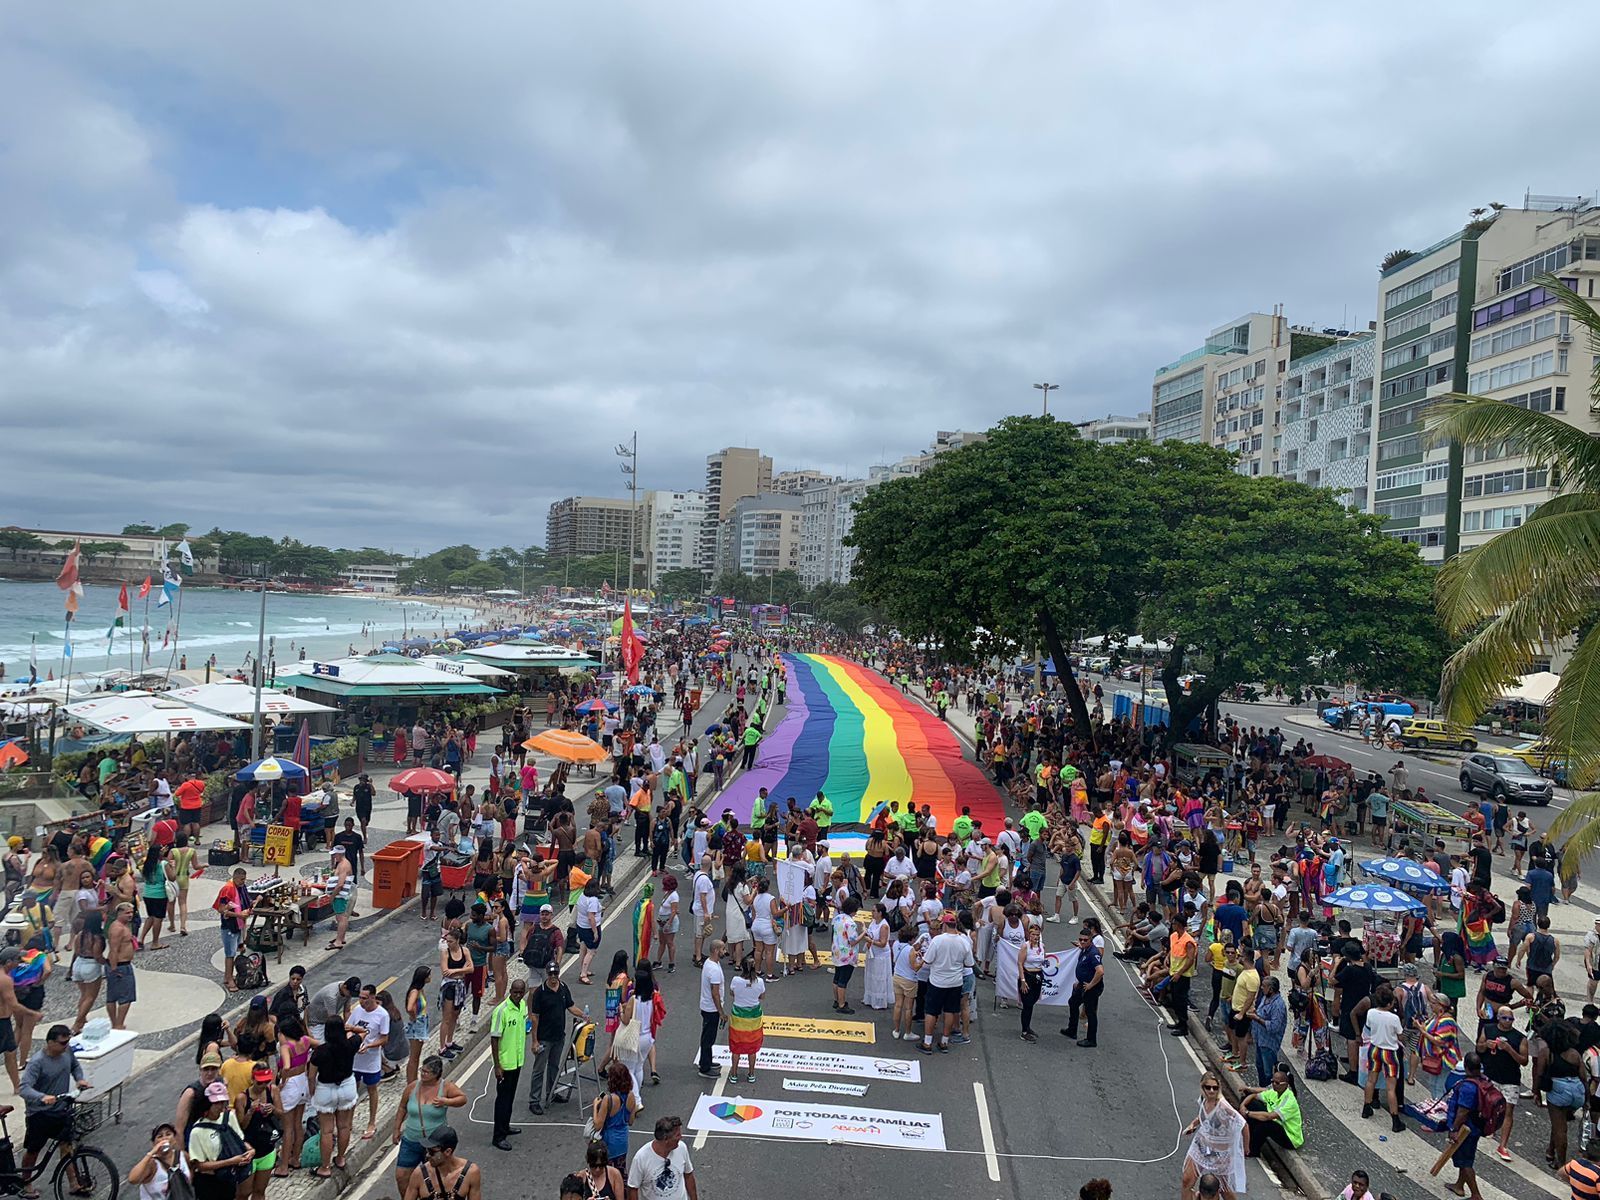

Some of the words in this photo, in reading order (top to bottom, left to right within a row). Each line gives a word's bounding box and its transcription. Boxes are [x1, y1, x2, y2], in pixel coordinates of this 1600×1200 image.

[799, 1028, 866, 1037] CORAGEM
[804, 1112, 848, 1120] TODAS
[869, 1117, 931, 1128] FAMÍLIAS
